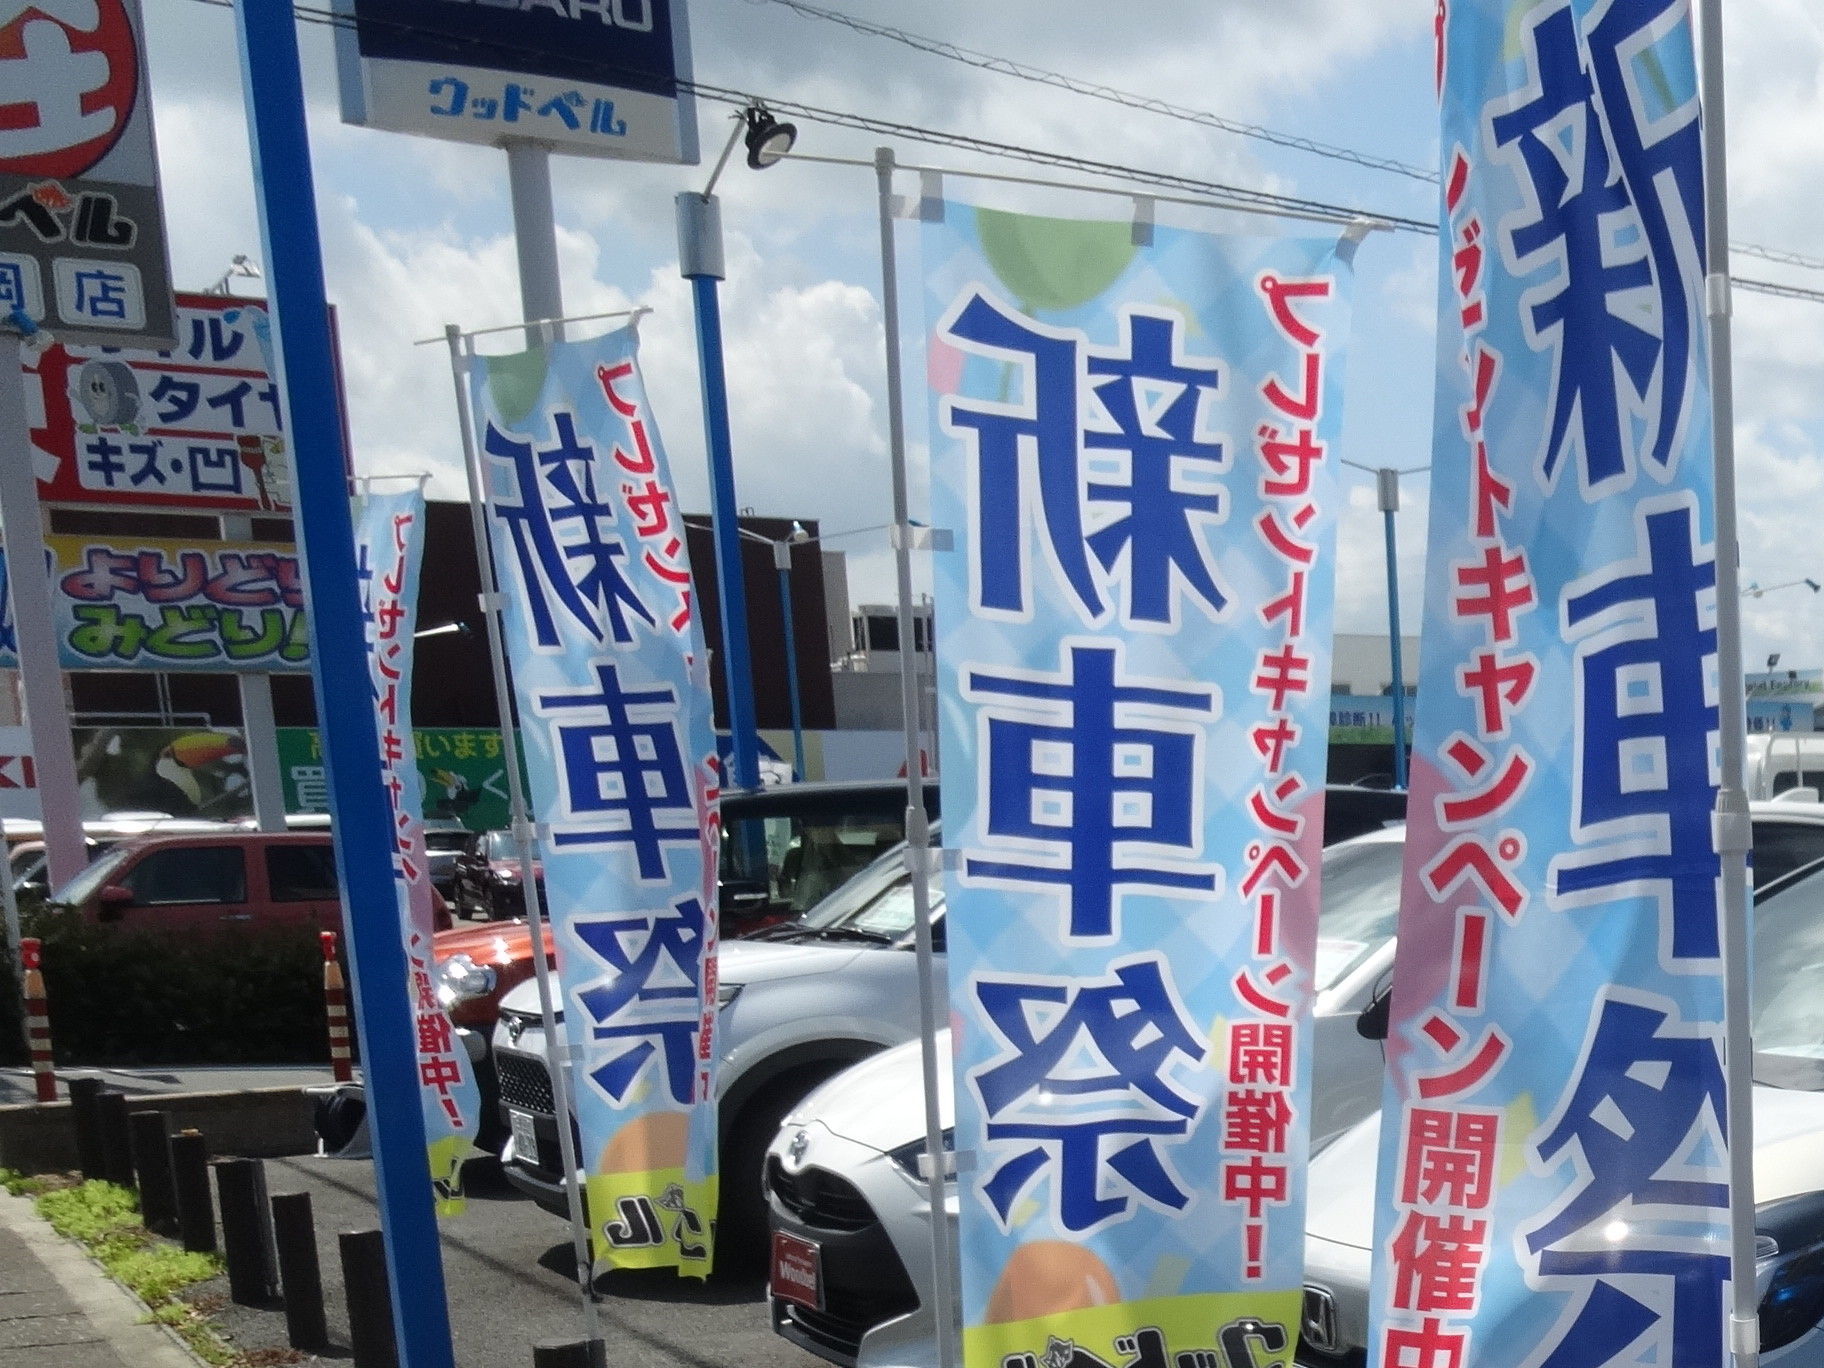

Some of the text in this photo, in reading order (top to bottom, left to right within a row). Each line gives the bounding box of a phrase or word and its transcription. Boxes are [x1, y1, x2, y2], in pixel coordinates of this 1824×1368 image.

[428, 76, 628, 137] ウッドベル
